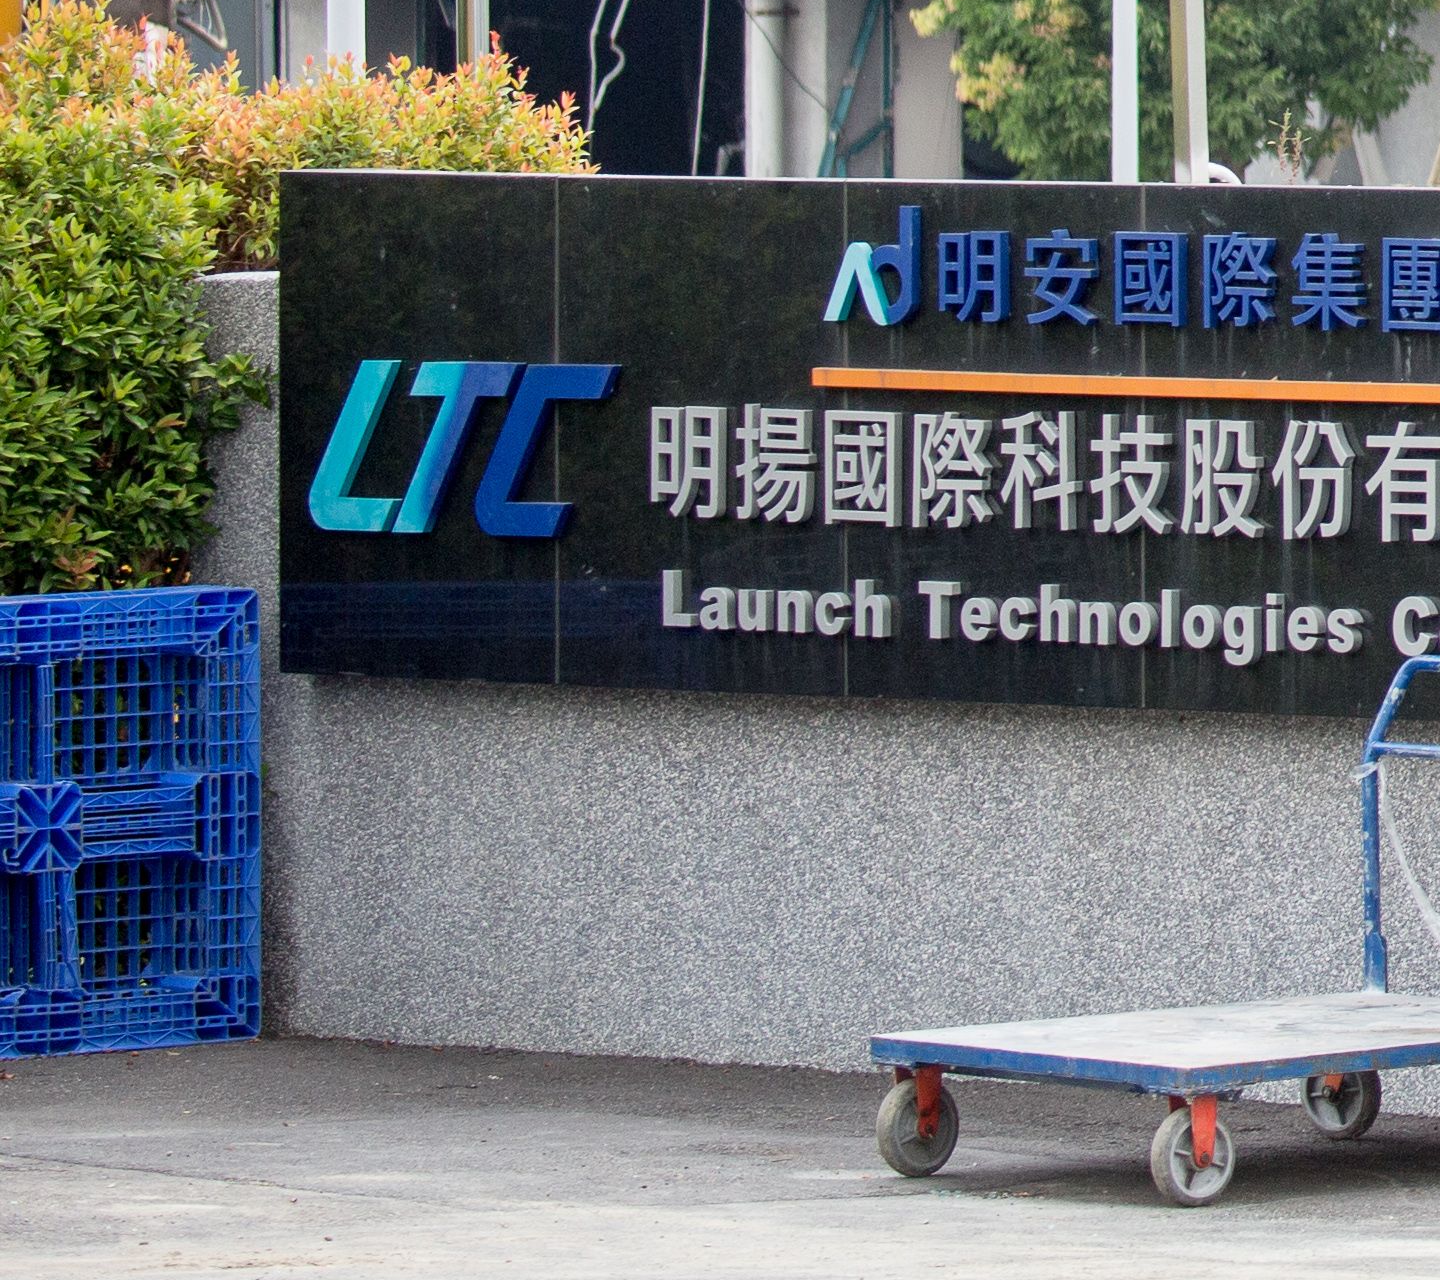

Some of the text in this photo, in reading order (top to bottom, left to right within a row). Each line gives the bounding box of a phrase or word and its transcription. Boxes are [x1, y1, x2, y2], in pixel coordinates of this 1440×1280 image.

[309, 359, 621, 537] LTC
[662, 569, 893, 639] Launch
[918, 580, 1366, 666] Technologies
